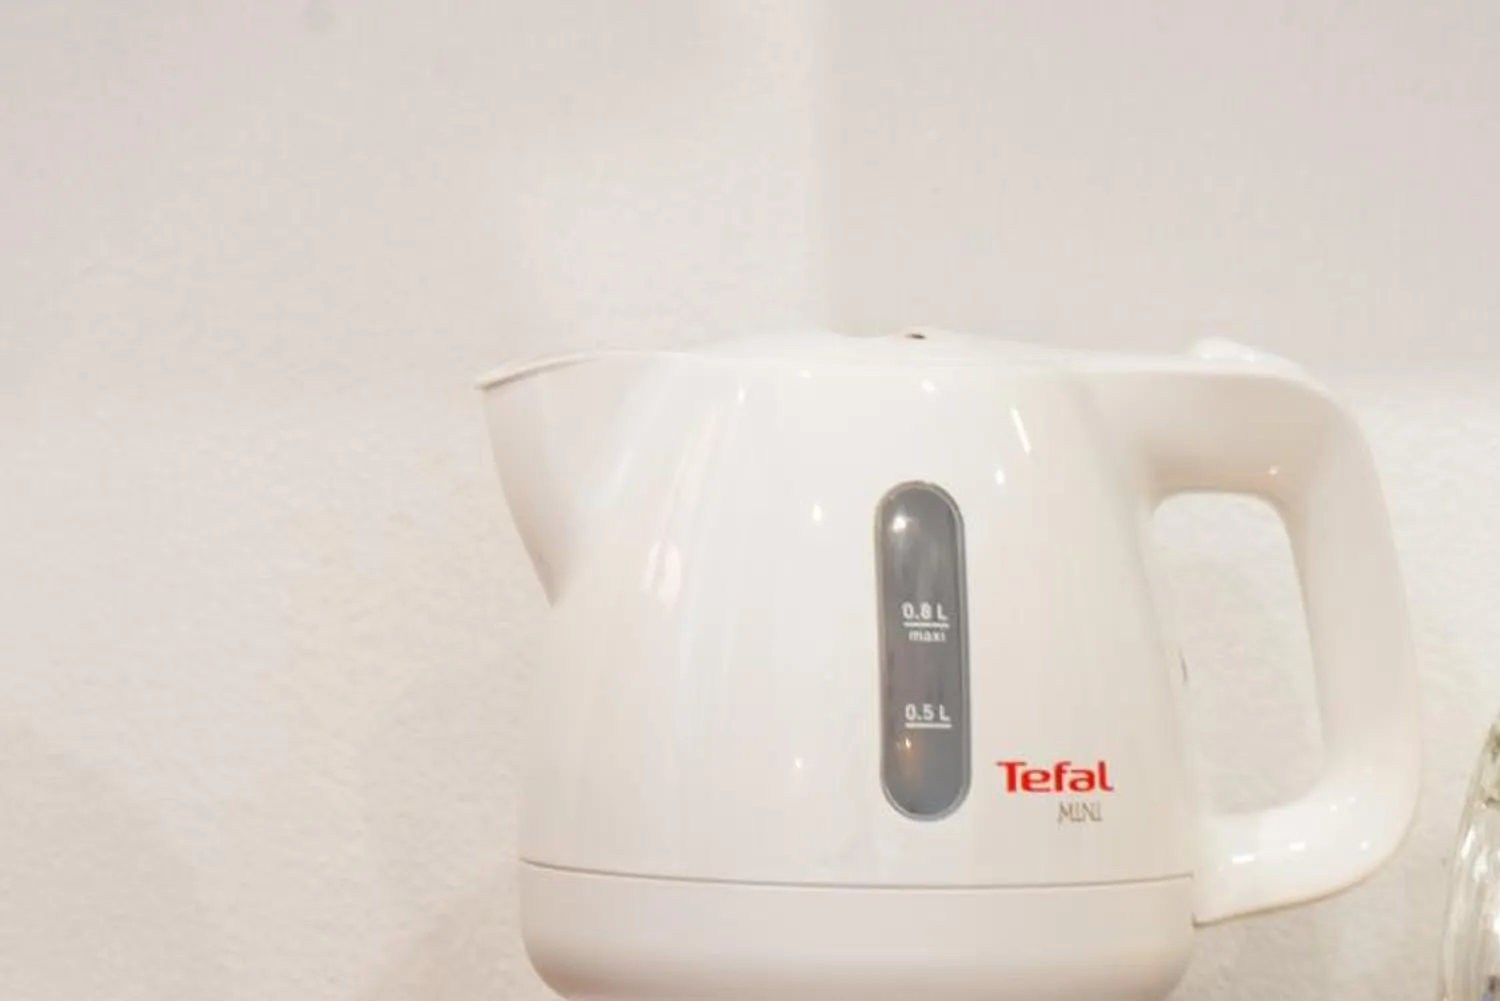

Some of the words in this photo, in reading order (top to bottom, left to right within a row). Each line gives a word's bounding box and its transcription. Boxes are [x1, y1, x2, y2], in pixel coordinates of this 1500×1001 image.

[901, 601, 932, 620] 0.8
[937, 602, 949, 620] L
[908, 629, 946, 642] maxi
[905, 703, 934, 721] 0.5
[939, 703, 951, 721] L
[995, 760, 1115, 793] Tefal
[1058, 801, 1103, 824] MINI
